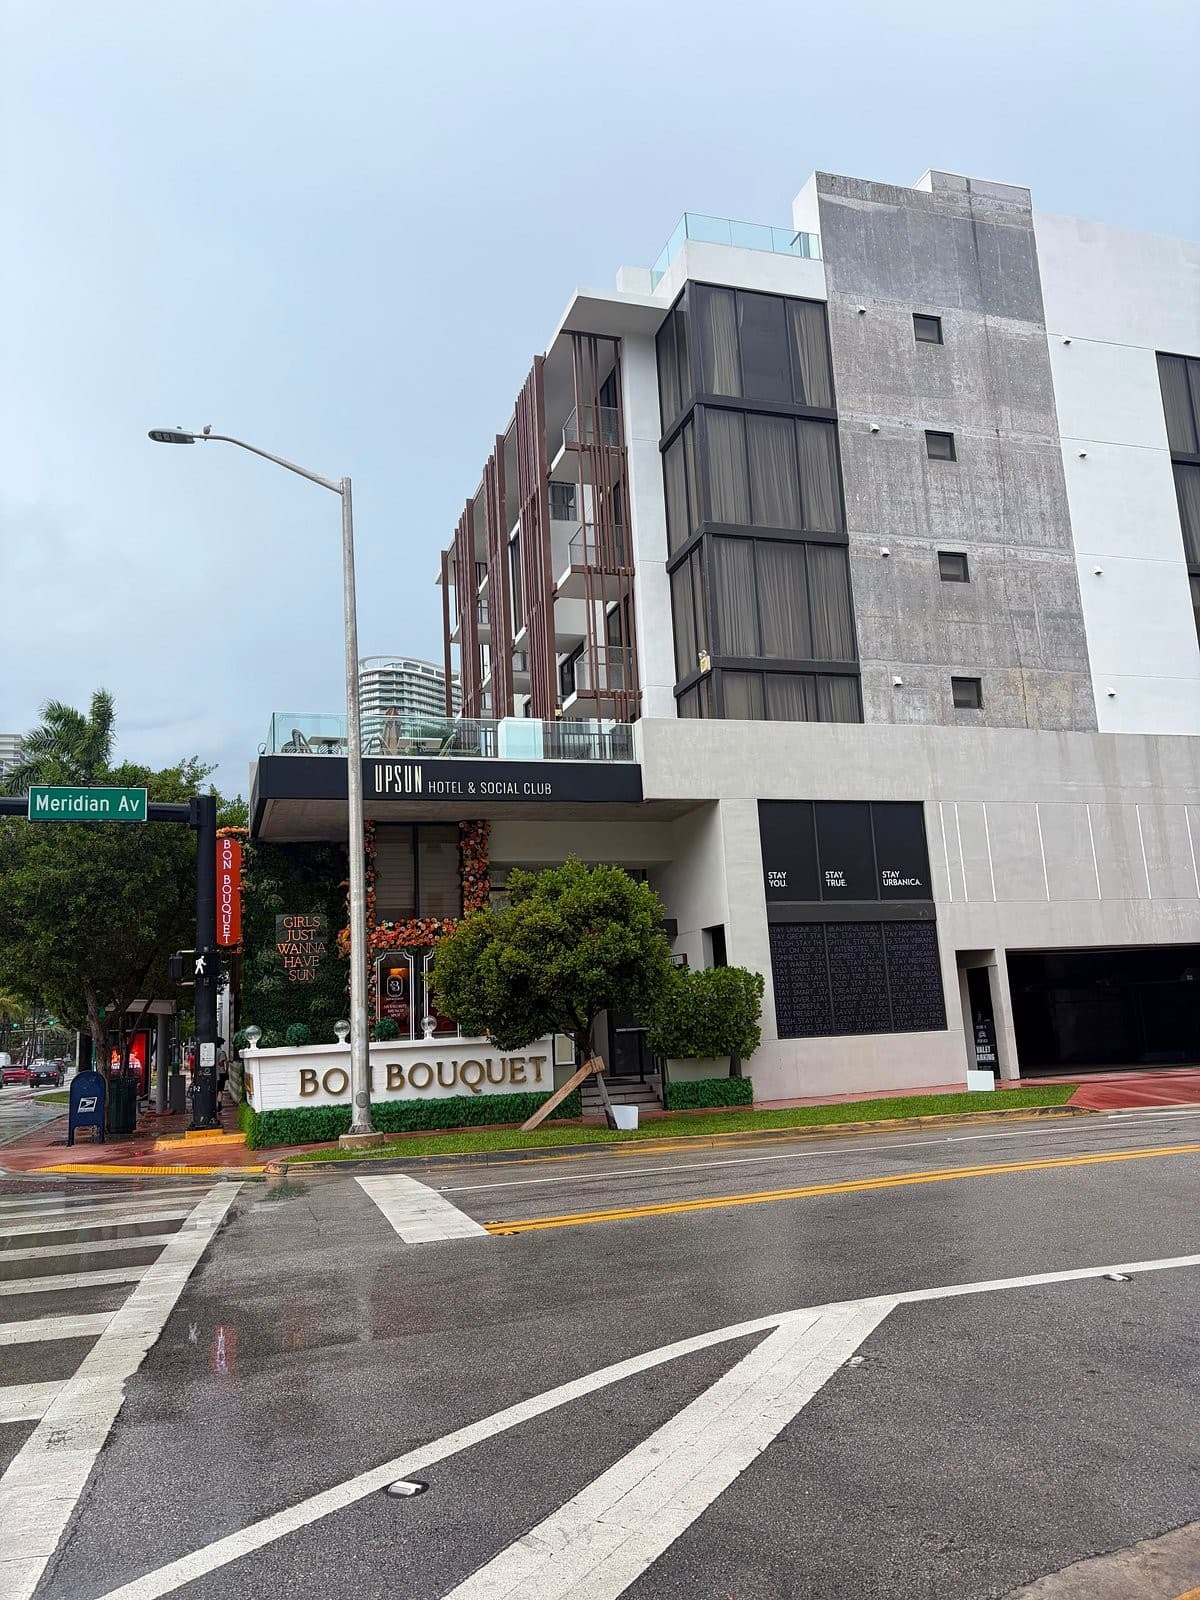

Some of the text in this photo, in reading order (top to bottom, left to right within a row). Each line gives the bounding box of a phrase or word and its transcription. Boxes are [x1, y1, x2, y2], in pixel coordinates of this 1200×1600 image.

[374, 764, 552, 795] UPSUN HOTEL & SOCIAL CLUB
[36, 794, 140, 812] Meridian Av
[768, 879, 788, 887] YOU.
[222, 839, 232, 944] BON BOUQUET
[283, 916, 321, 928] GIRLS
[286, 930, 316, 942] JUST
[276, 942, 326, 955] WANNA
[284, 956, 320, 968] HAVE
[288, 968, 316, 981] SUN
[386, 1056, 547, 1094] BOUQUET
